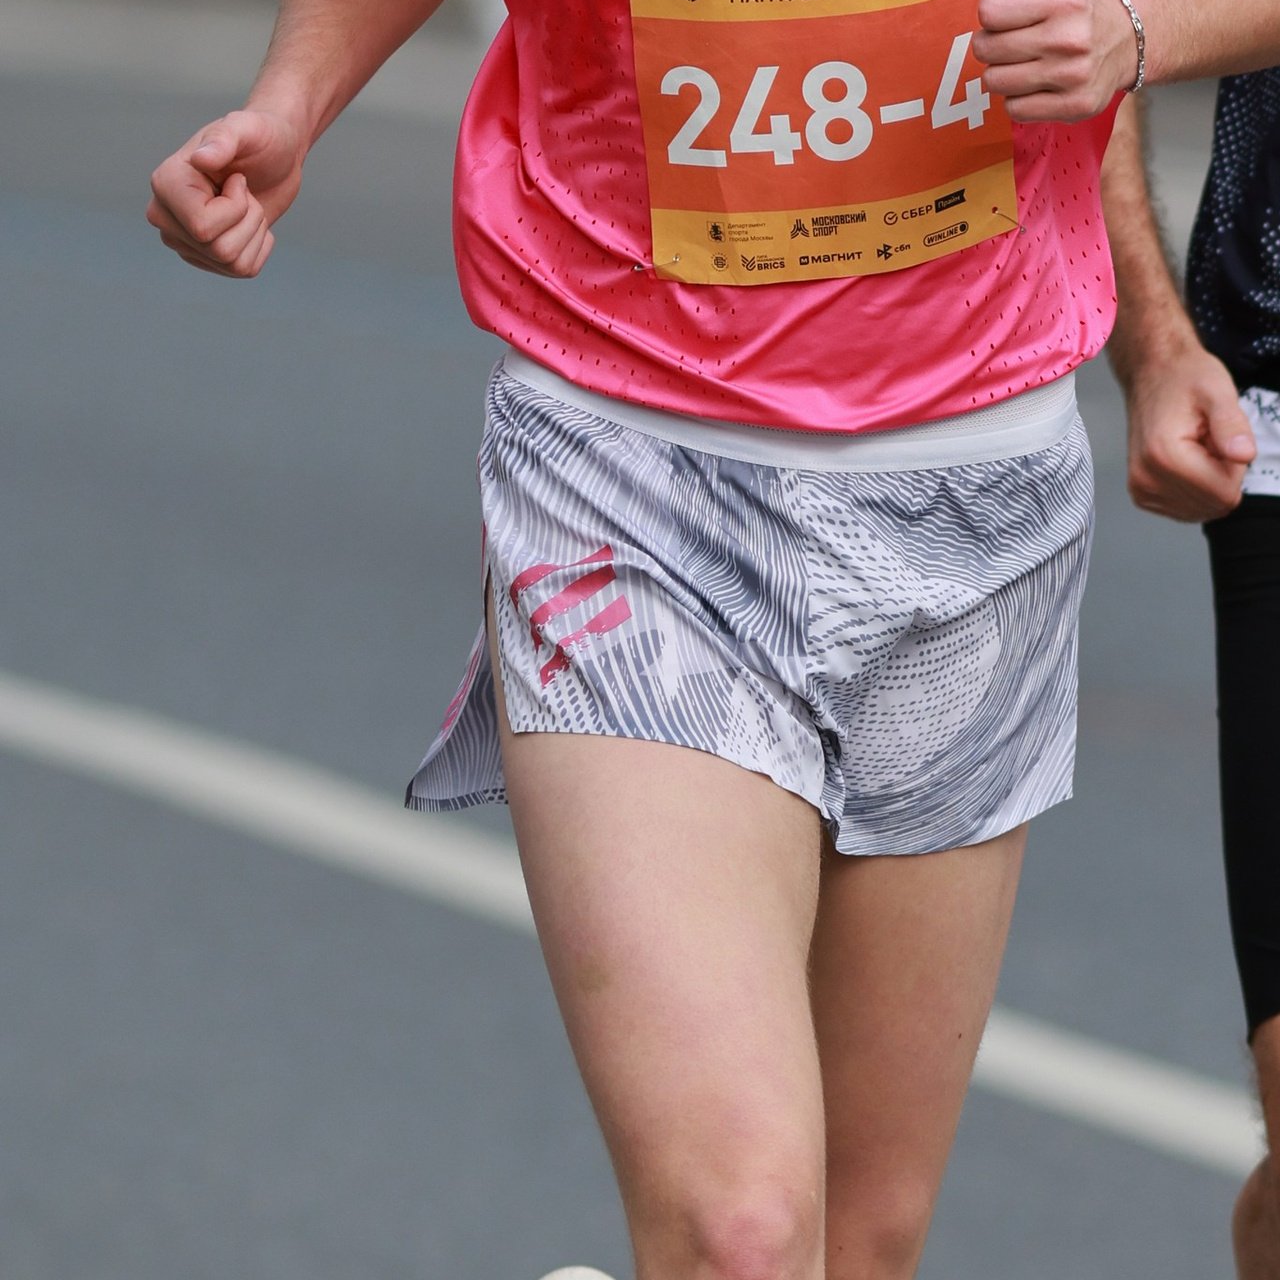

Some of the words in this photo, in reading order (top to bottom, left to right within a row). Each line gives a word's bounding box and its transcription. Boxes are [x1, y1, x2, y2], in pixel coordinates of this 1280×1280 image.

[660, 31, 990, 168] 248-4
[811, 210, 867, 227] МОСКОВСКИЙ
[901, 204, 933, 221] СБЕР
[813, 226, 838, 238] СПОРТ
[927, 226, 959, 244] WINLINE
[757, 261, 786, 271] BRICS
